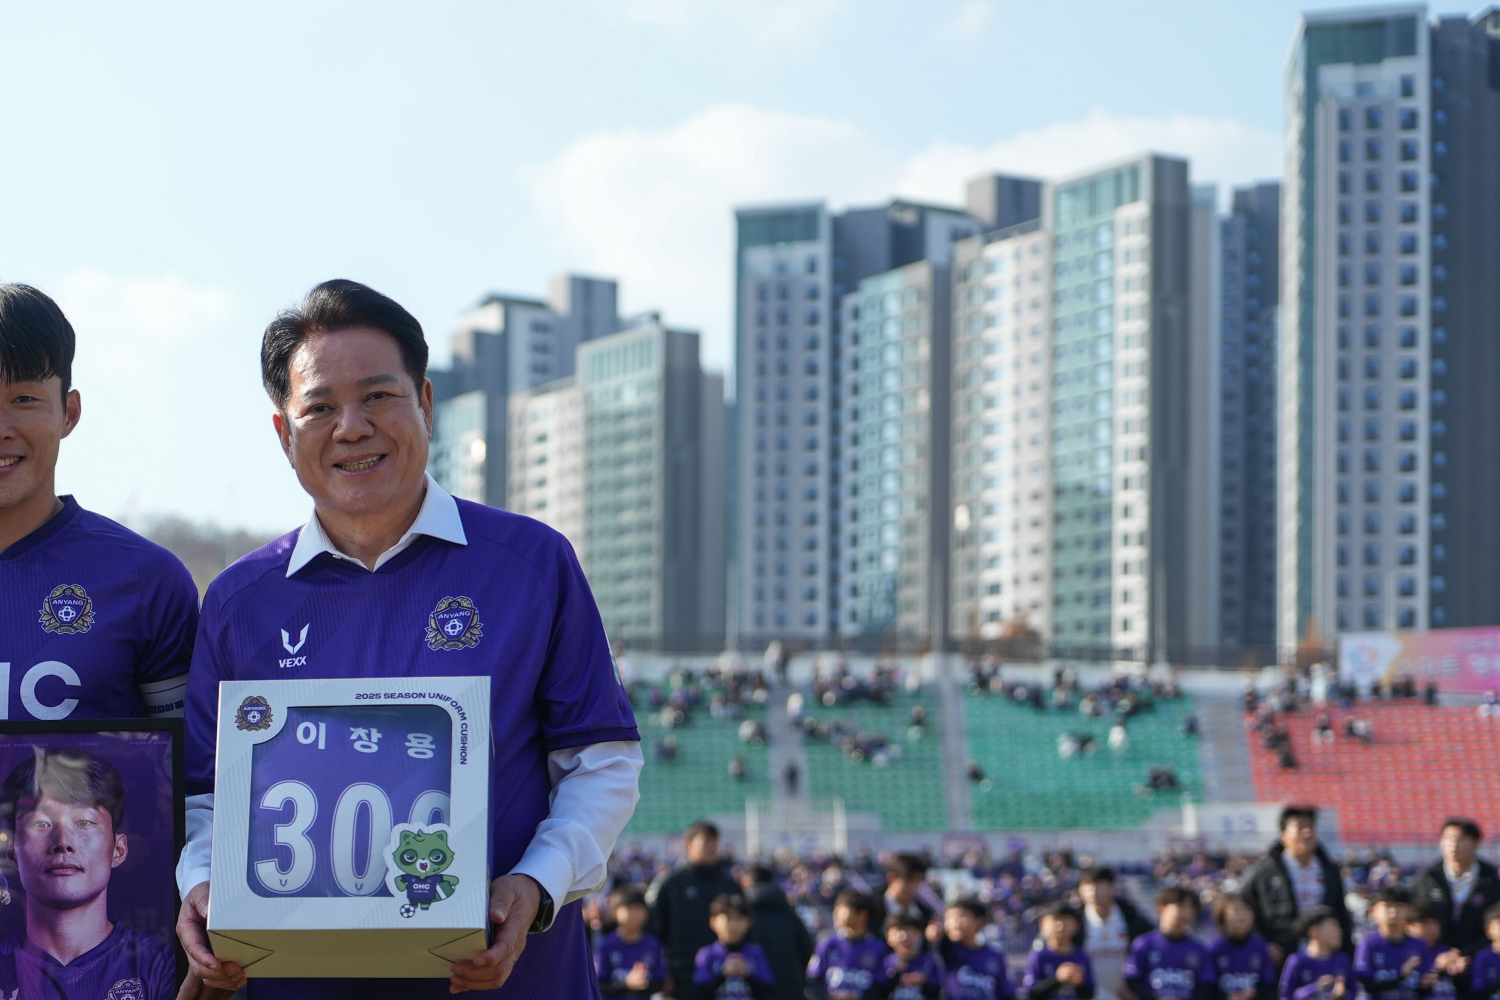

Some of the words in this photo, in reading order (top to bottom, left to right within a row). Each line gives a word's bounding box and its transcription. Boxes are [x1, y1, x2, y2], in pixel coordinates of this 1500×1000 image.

[437, 610, 471, 619] ANYANG
[278, 656, 307, 668] VEXX
[355, 692, 382, 700] 2025
[428, 692, 468, 721] UNIFORM
[459, 722, 468, 765] CUSHION
